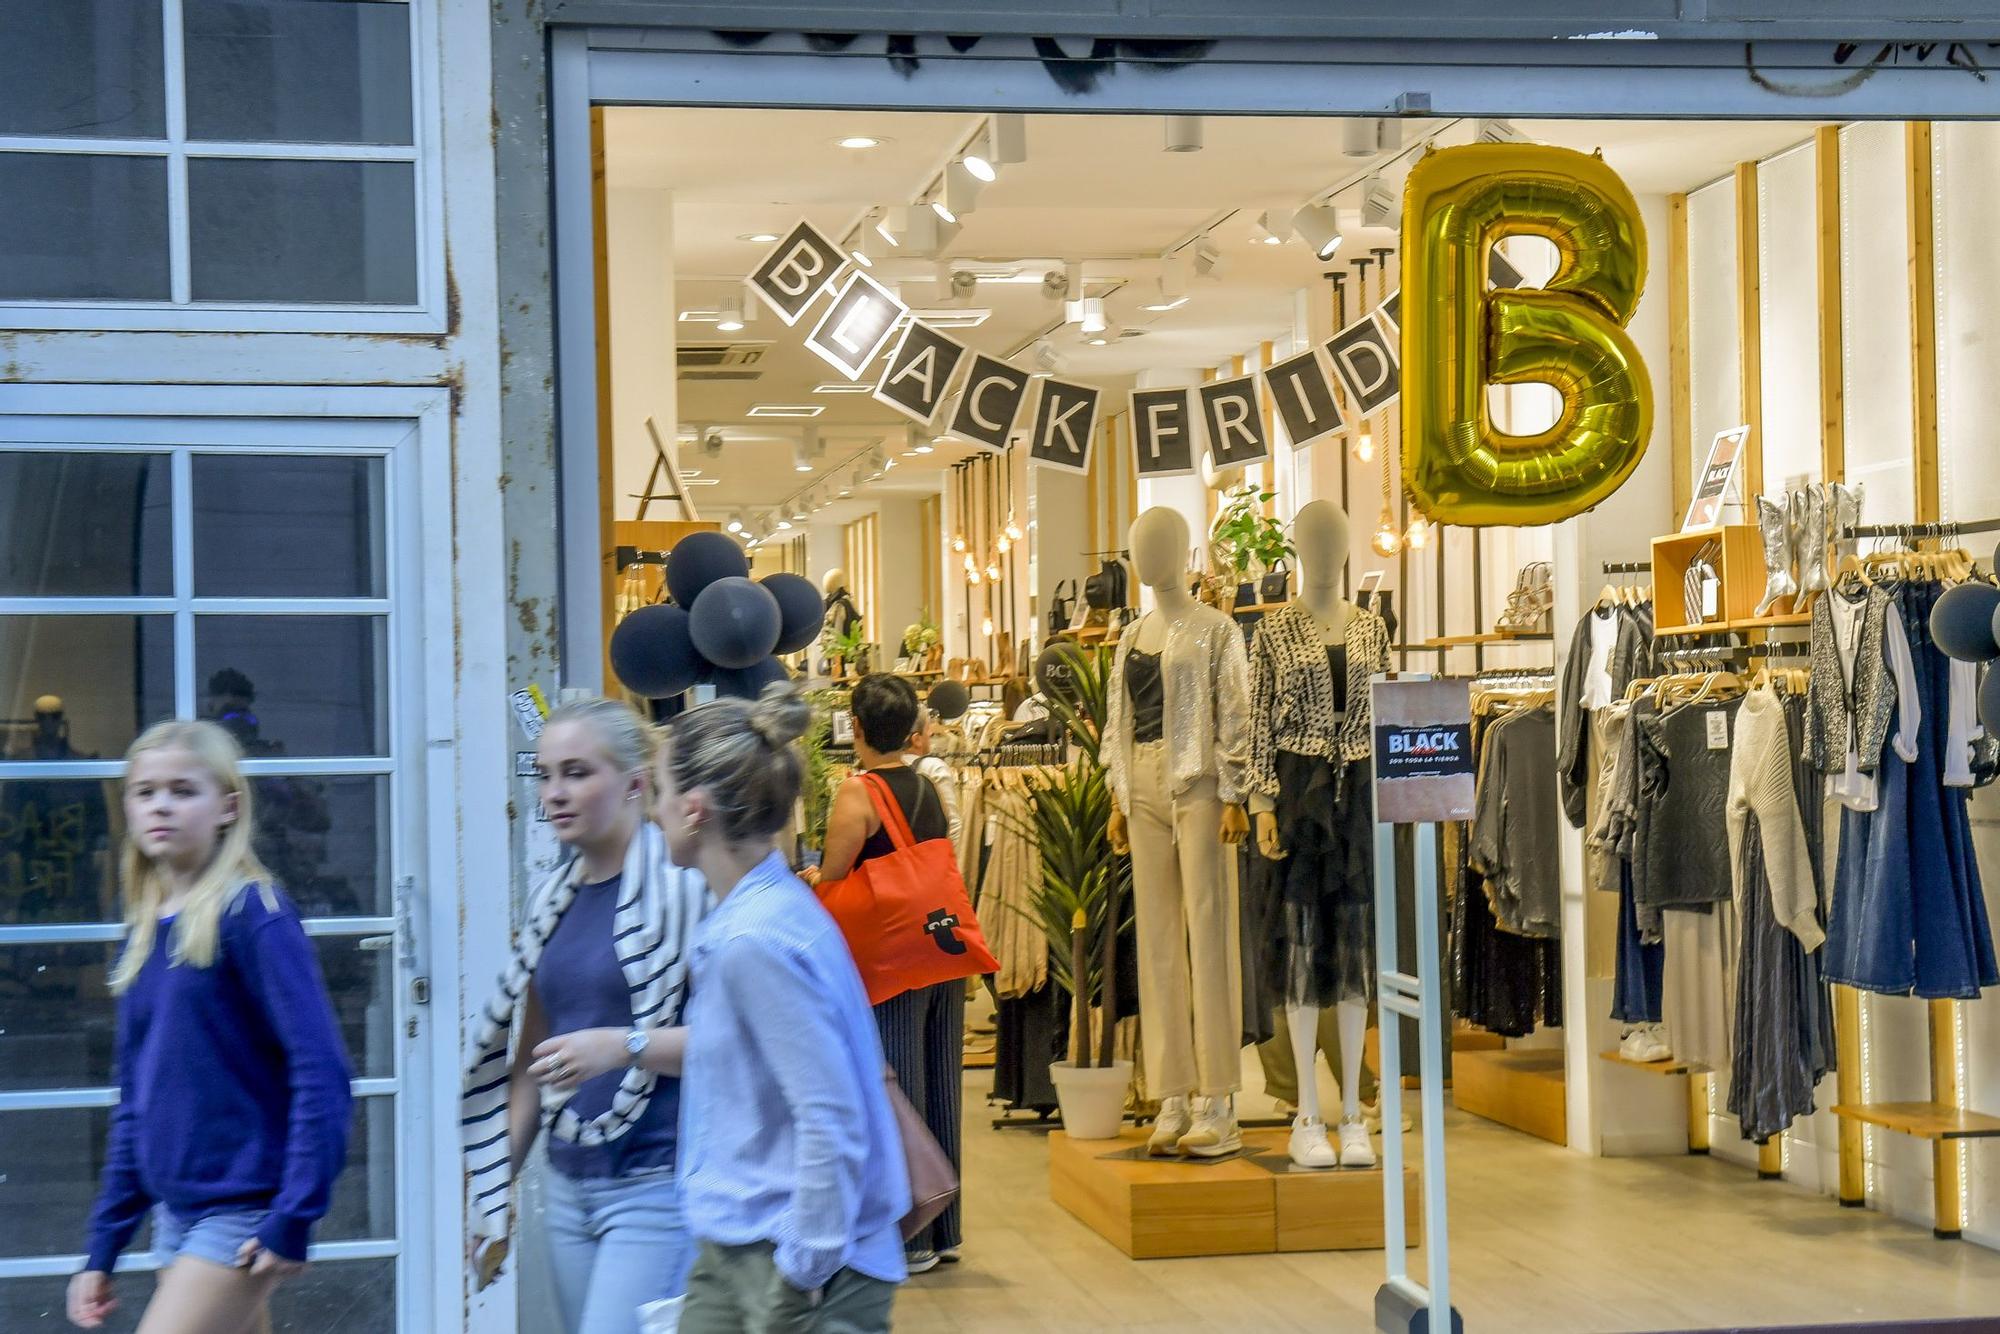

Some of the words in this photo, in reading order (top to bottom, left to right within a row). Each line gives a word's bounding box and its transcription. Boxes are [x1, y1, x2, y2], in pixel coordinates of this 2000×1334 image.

[768, 238, 1088, 454] BLACK
[1147, 339, 1390, 458] FRID
[1400, 142, 1654, 527] B
[1389, 731, 1460, 754] BLACK
